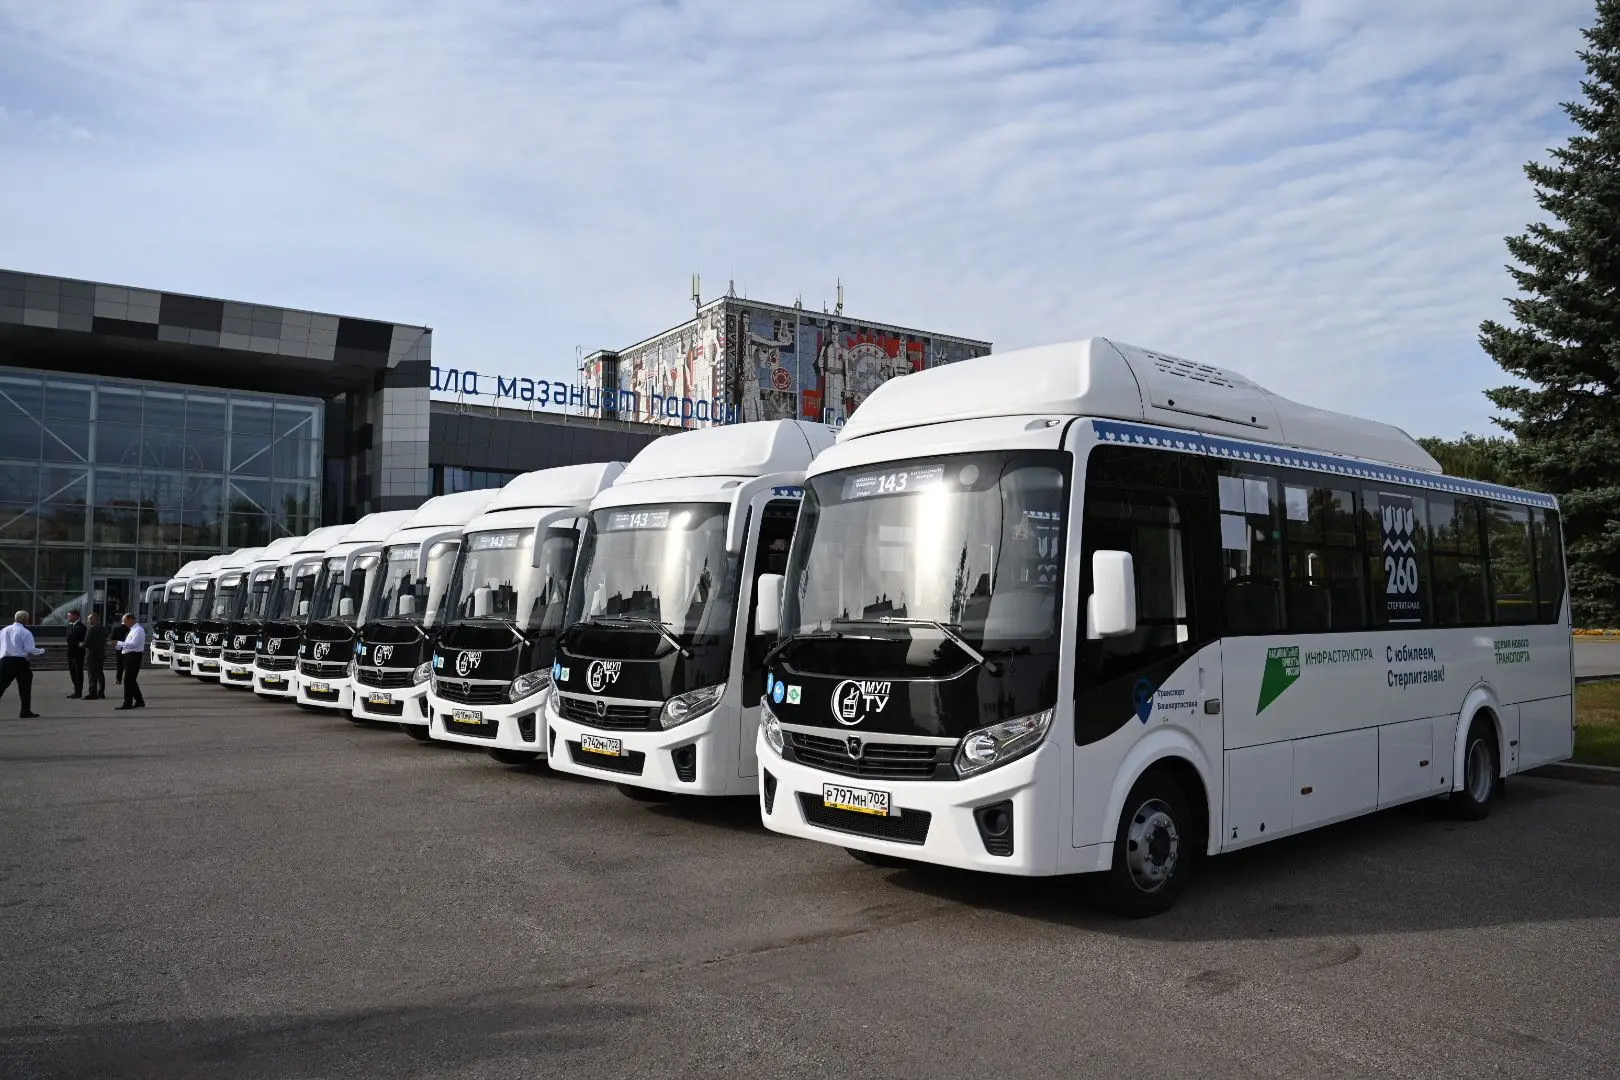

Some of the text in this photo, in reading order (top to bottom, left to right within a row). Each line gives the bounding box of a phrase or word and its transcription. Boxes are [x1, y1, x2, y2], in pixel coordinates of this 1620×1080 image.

[877, 471, 908, 493] 143
[629, 512, 649, 527] 143
[1384, 555, 1418, 594] 260
[1304, 647, 1375, 666] ИНФРАСТРУКТУРА
[1386, 644, 1436, 663] С юбилеем,
[1387, 664, 1445, 690] Стерлитамак!
[865, 681, 892, 694] МУП
[826, 787, 886, 806] Р797МН 702
